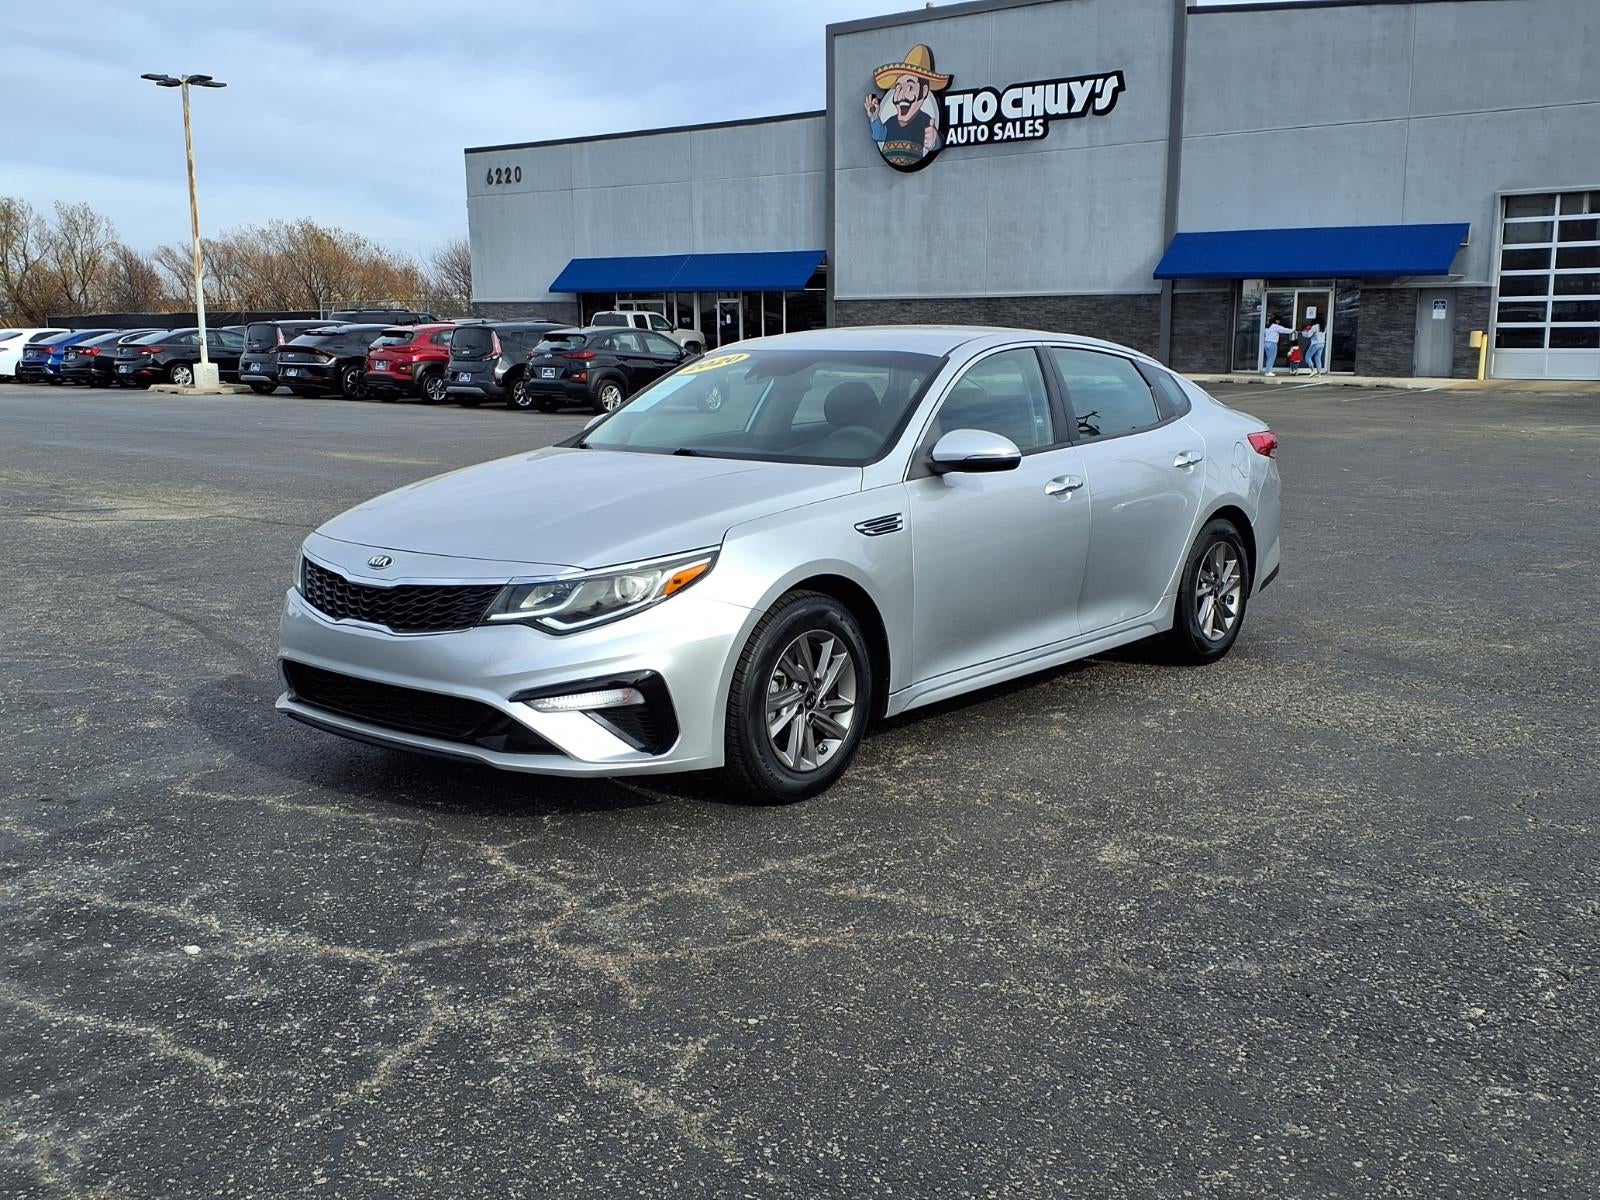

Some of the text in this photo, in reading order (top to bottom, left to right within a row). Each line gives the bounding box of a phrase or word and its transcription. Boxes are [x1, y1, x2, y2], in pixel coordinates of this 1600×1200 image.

[945, 75, 1118, 125] TIO CHUY'S
[946, 119, 1044, 145] AUTO SALES
[487, 166, 521, 185] 6220
[369, 556, 389, 566] KIA
